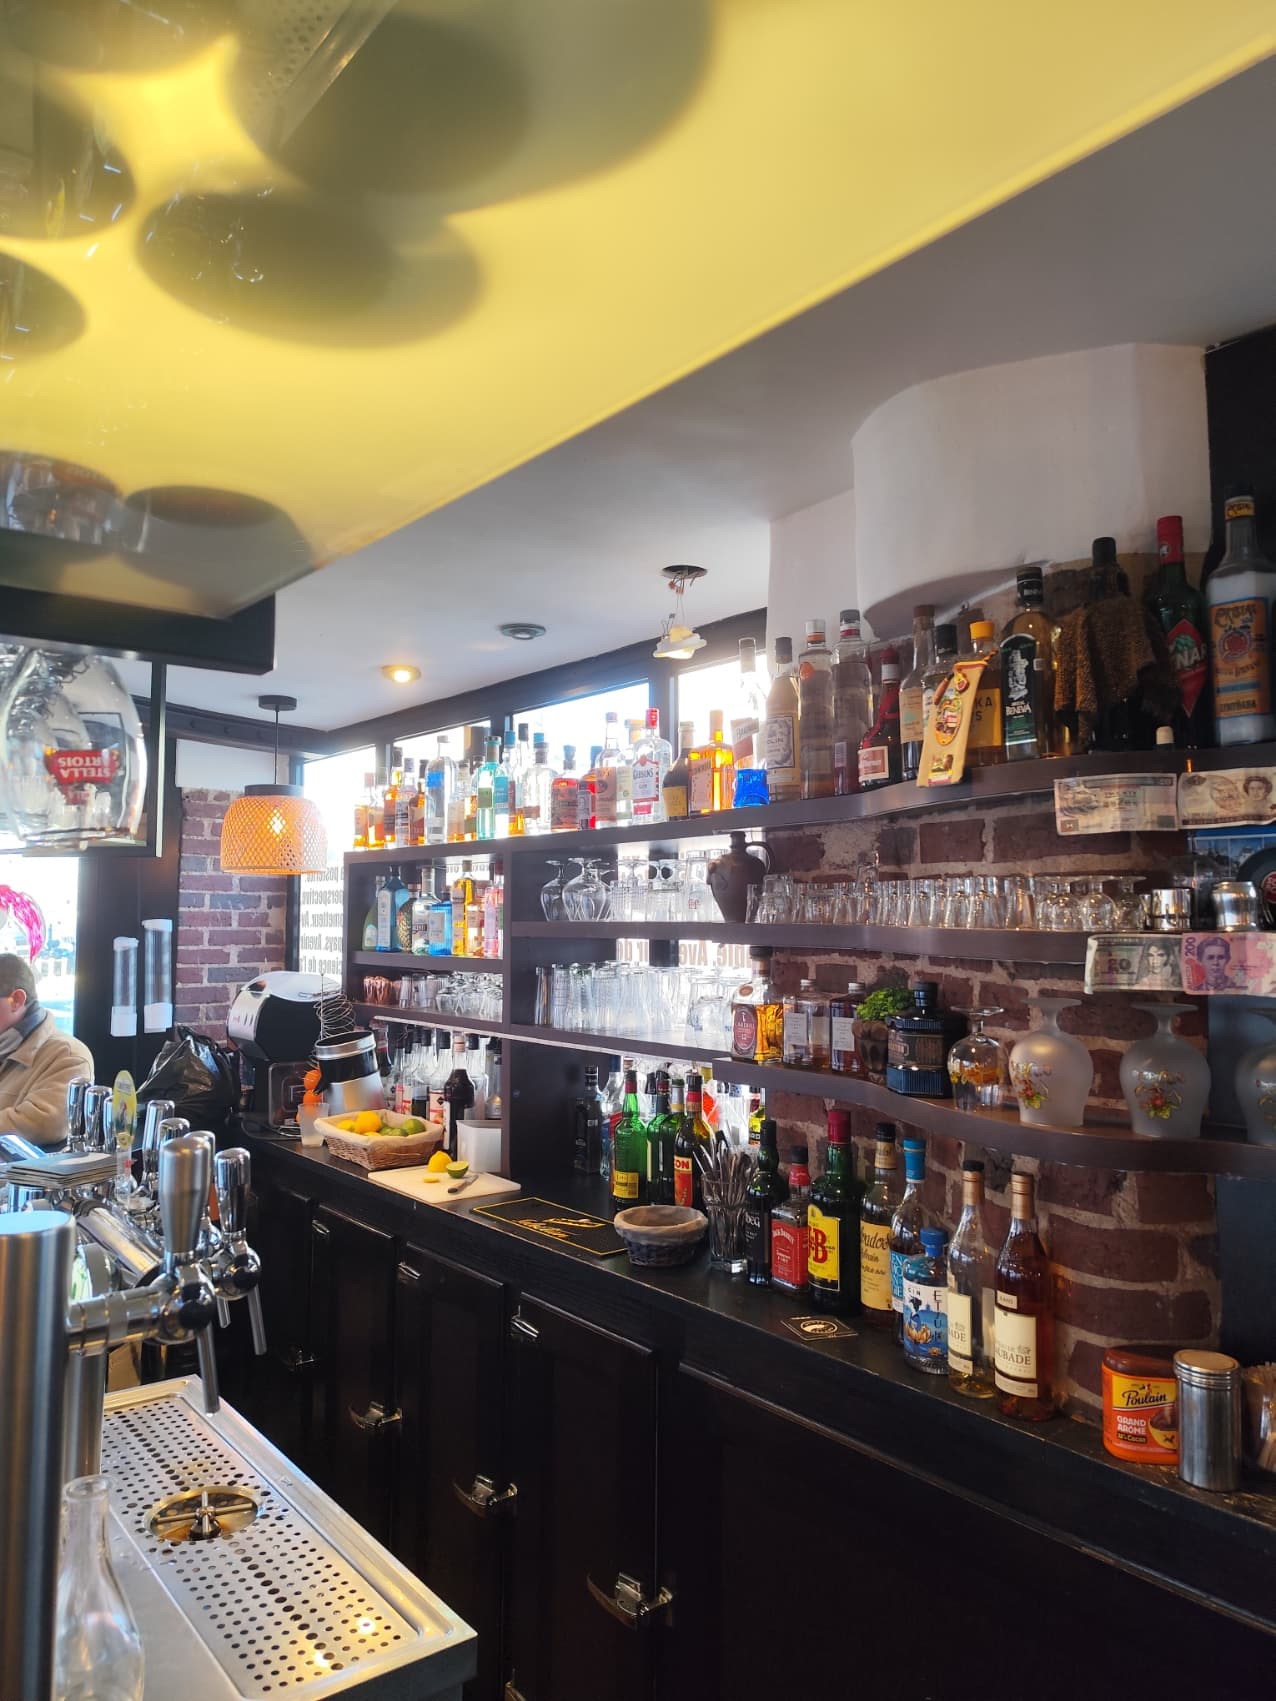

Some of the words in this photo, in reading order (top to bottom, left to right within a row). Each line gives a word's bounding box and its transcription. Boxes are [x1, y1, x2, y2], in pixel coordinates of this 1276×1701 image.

[60, 767, 111, 778] STELLA
[1123, 1390, 1166, 1406] Poulain
[1118, 1415, 1146, 1426] GRAND
